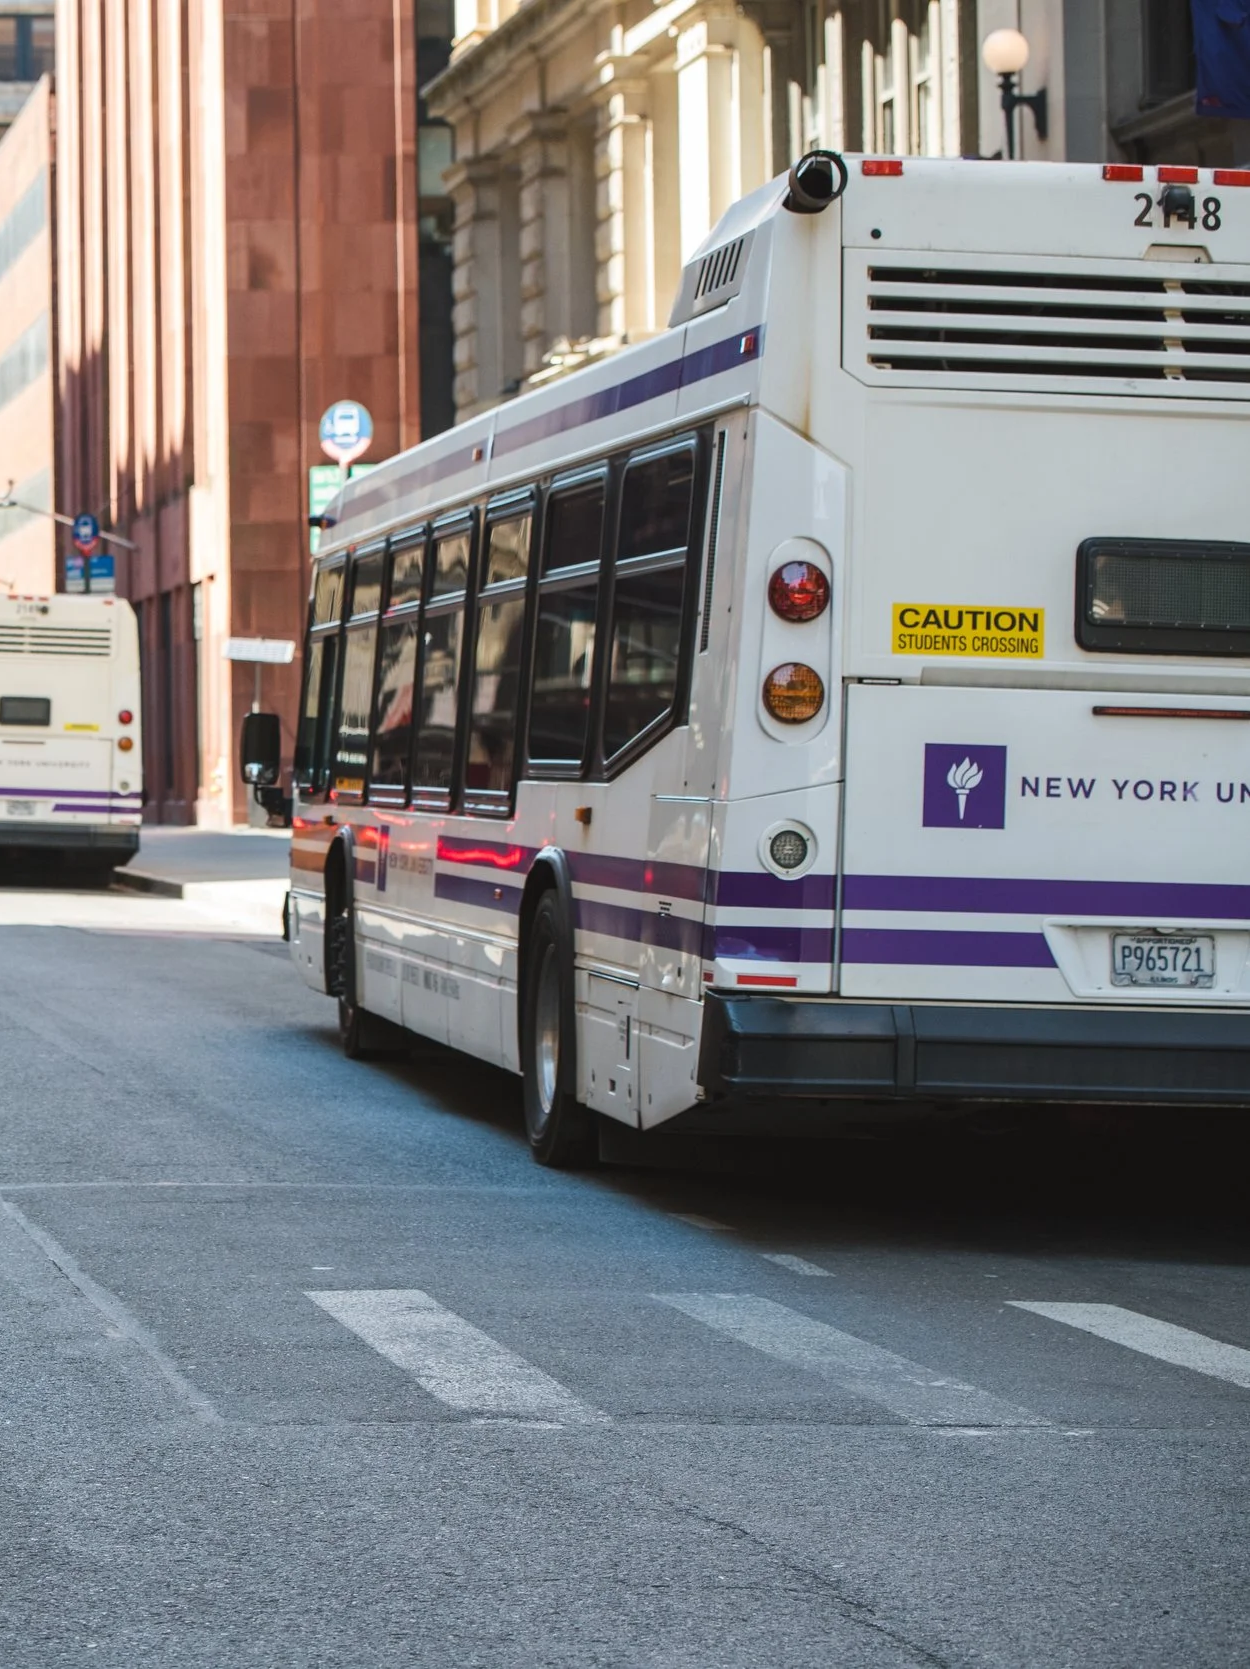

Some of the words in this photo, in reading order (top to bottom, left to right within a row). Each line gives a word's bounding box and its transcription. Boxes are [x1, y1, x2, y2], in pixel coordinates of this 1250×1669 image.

[899, 608, 1038, 632] CAUTION
[898, 634, 967, 651] STUDENTS
[972, 636, 1038, 653] CROSSING
[1021, 776, 1095, 799] NEW
[1112, 779, 1199, 802] YORK
[1217, 782, 1250, 803] UN
[1121, 945, 1204, 972] P965721
